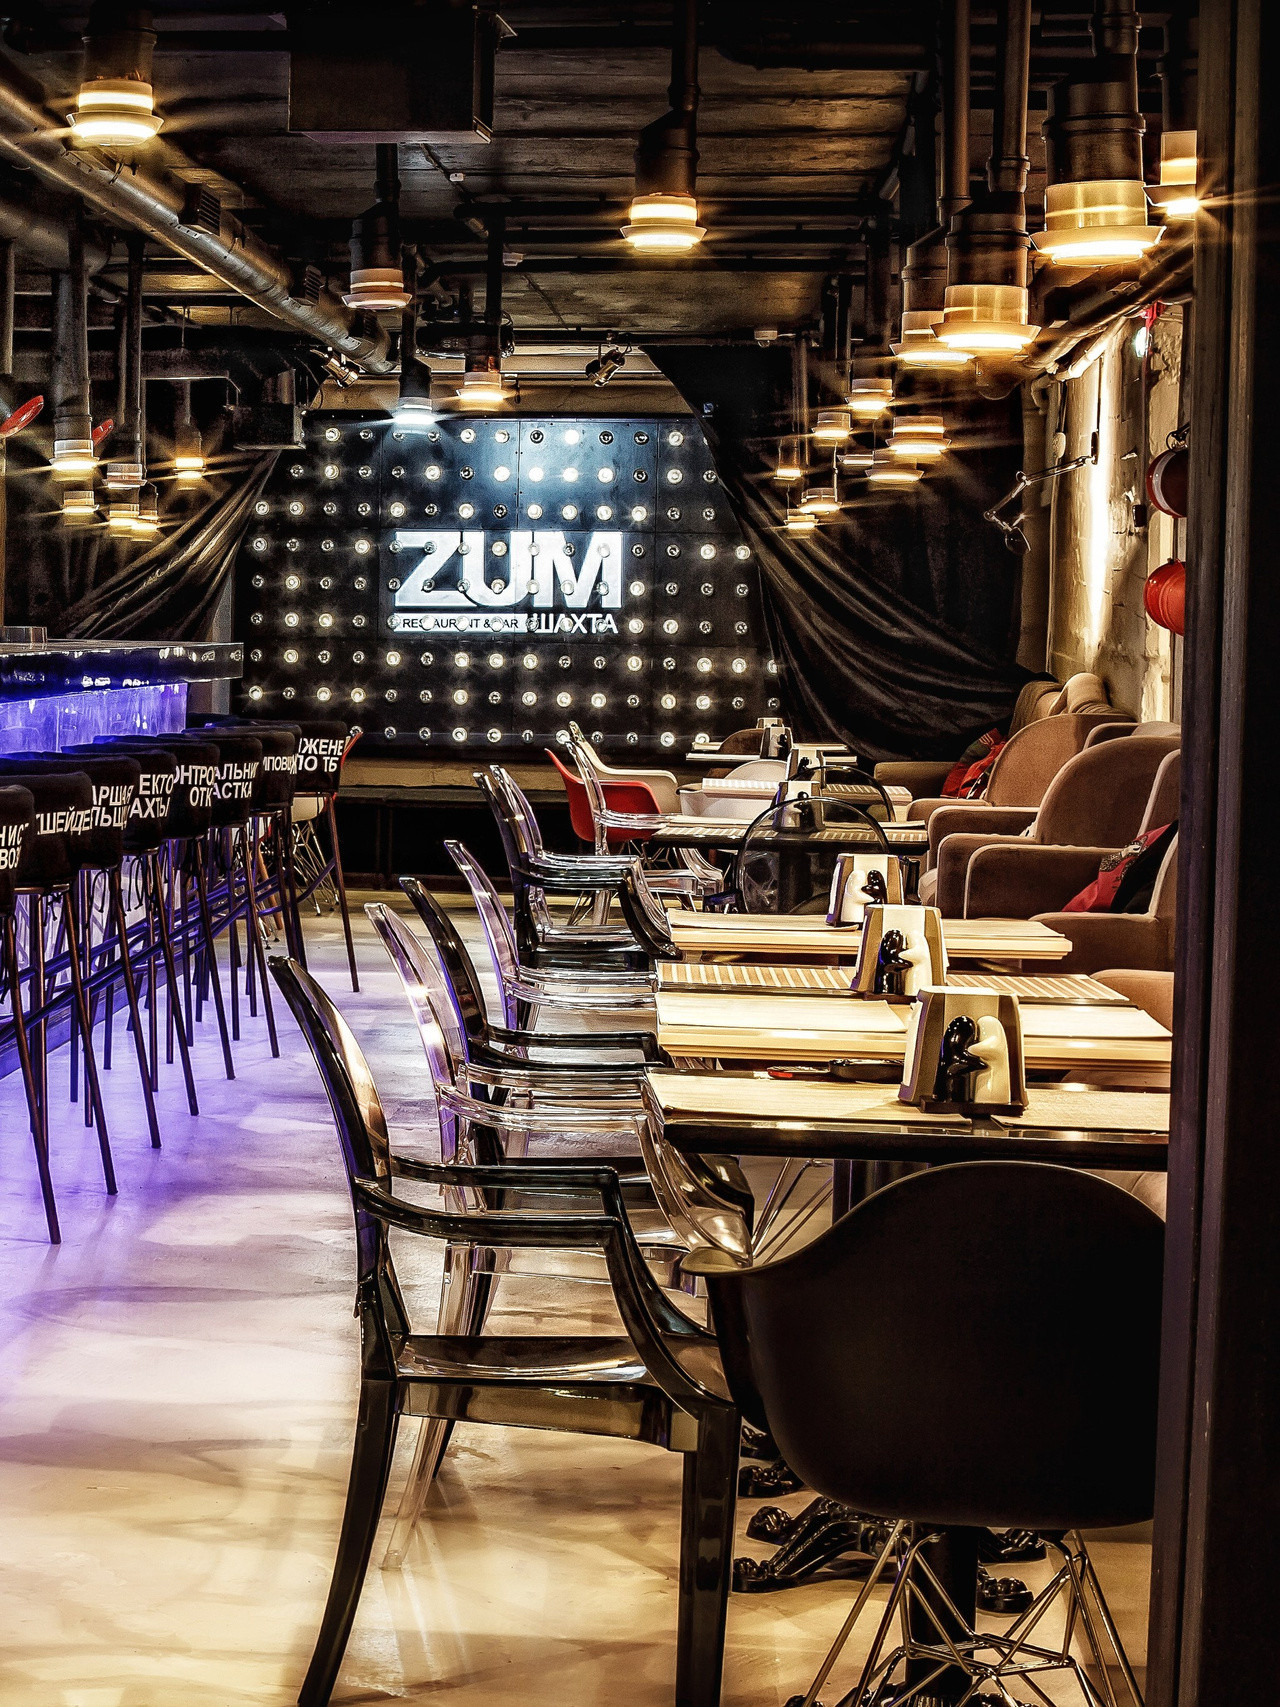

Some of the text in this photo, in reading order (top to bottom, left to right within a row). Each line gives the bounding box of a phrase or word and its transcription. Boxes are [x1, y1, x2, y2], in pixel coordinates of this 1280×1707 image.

[395, 531, 622, 608] ZUM
[402, 616, 479, 628] RESAURNT
[534, 613, 619, 634] ШАХТА
[323, 756, 339, 772] ТБ
[190, 786, 213, 806] ОТК
